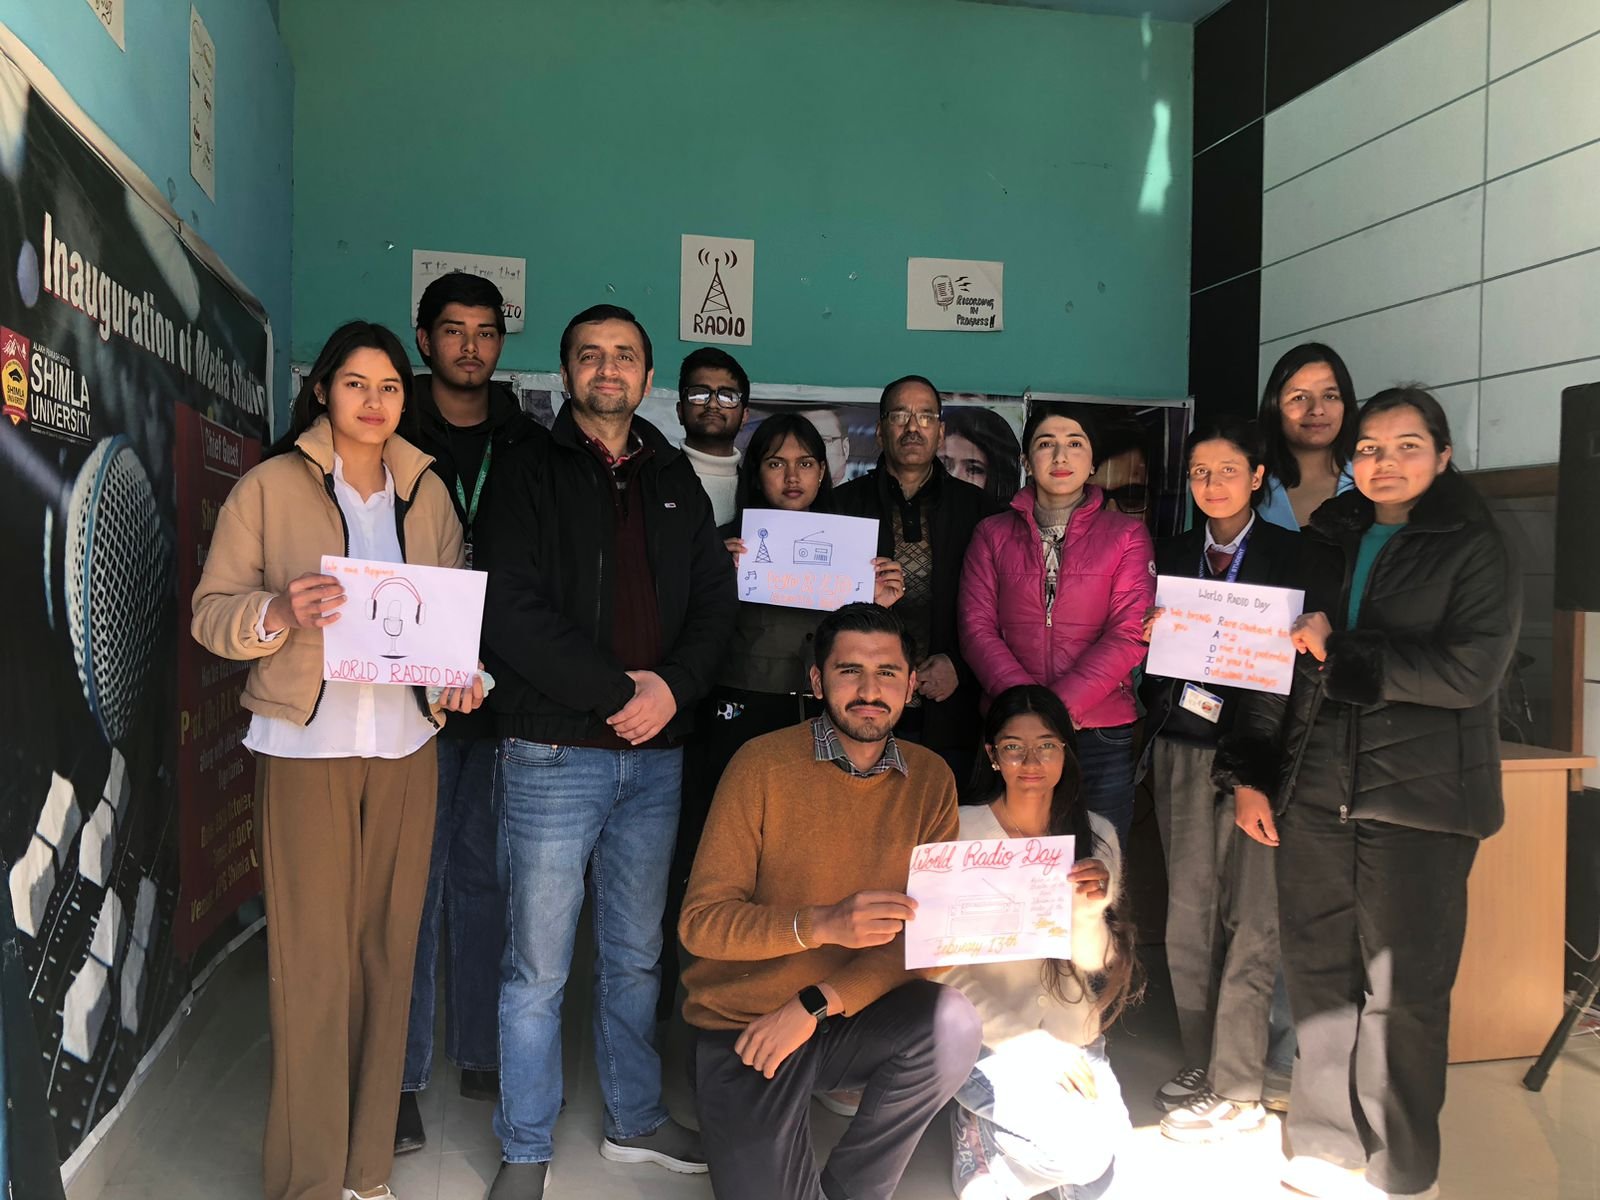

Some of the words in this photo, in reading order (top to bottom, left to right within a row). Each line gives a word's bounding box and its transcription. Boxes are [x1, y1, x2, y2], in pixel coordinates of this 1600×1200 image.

[43, 211, 176, 364] Inauguration
[180, 323, 192, 375] of
[195, 329, 231, 401] Media
[693, 313, 746, 337] RADIO
[7, 385, 25, 398] SHIMLA
[31, 352, 91, 411] SHIMLA
[31, 393, 91, 436] UNIVERSITY
[327, 659, 379, 680] WORLD
[390, 663, 441, 683] RADIO
[445, 668, 470, 686] DAY
[910, 845, 956, 870] World
[963, 841, 1016, 867] Radio
[1021, 839, 1063, 876] Day
